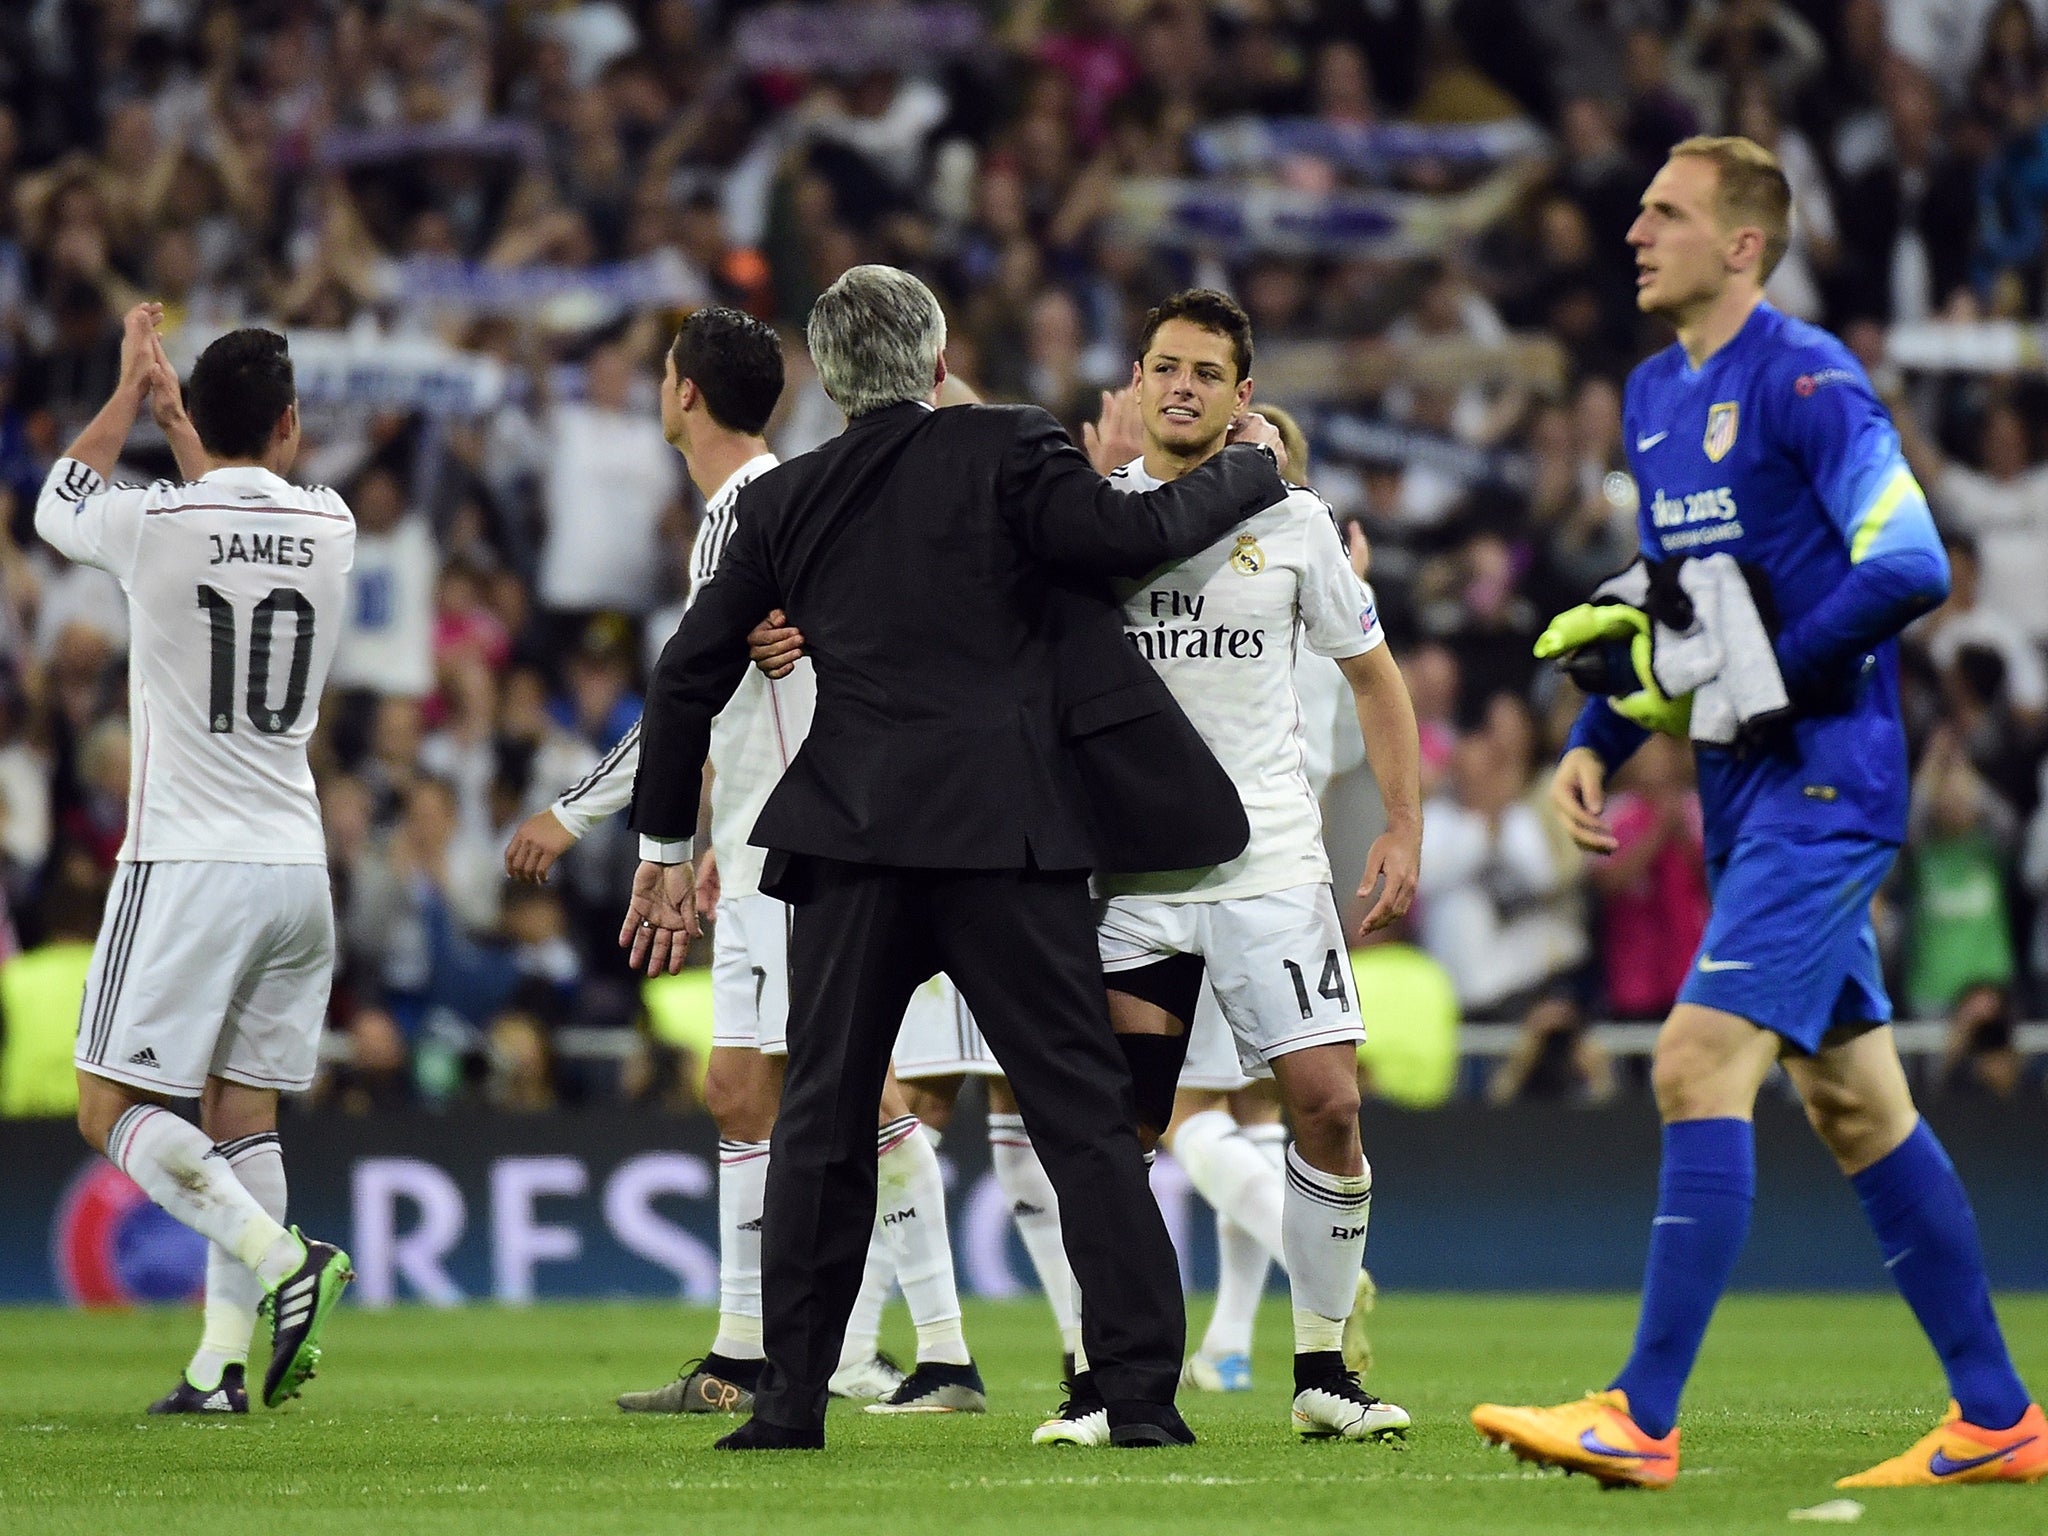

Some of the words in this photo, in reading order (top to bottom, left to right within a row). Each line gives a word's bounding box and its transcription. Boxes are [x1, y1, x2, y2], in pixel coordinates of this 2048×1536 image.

[209, 533, 316, 568] JAMES
[1150, 590, 1205, 622] Fly
[197, 584, 316, 733] 10
[1125, 620, 1265, 661] mirates
[751, 965, 767, 1022] 7
[1283, 949, 1350, 1020] 14
[1331, 1225, 1366, 1240] RM
[701, 1378, 738, 1411] CR
